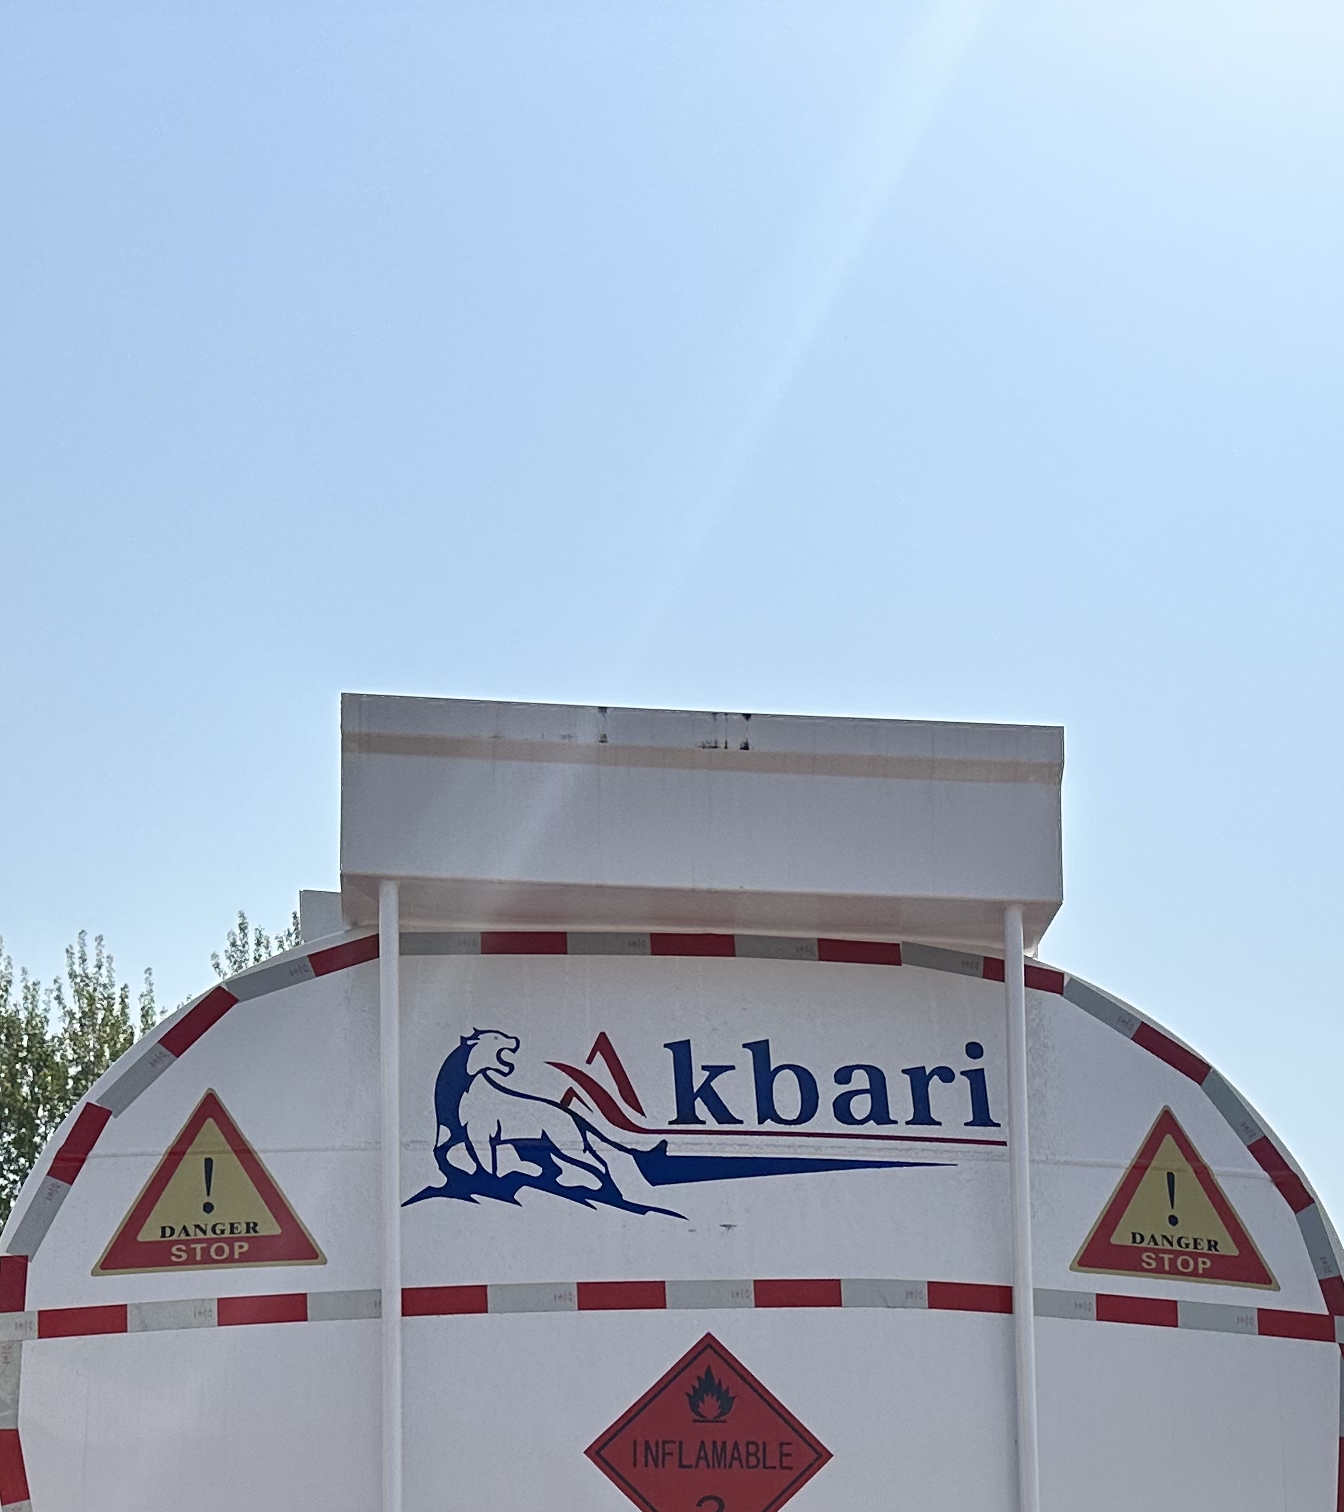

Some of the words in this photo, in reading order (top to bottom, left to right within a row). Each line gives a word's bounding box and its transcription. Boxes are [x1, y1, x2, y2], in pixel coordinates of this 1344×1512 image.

[544, 1031, 1002, 1134] Akbari
[160, 1221, 260, 1239] DANGER
[170, 1241, 249, 1262] STOP
[1131, 1231, 1219, 1252] DANGER
[1141, 1252, 1211, 1274] STOP
[632, 1440, 793, 1470] INFLAMABLE
